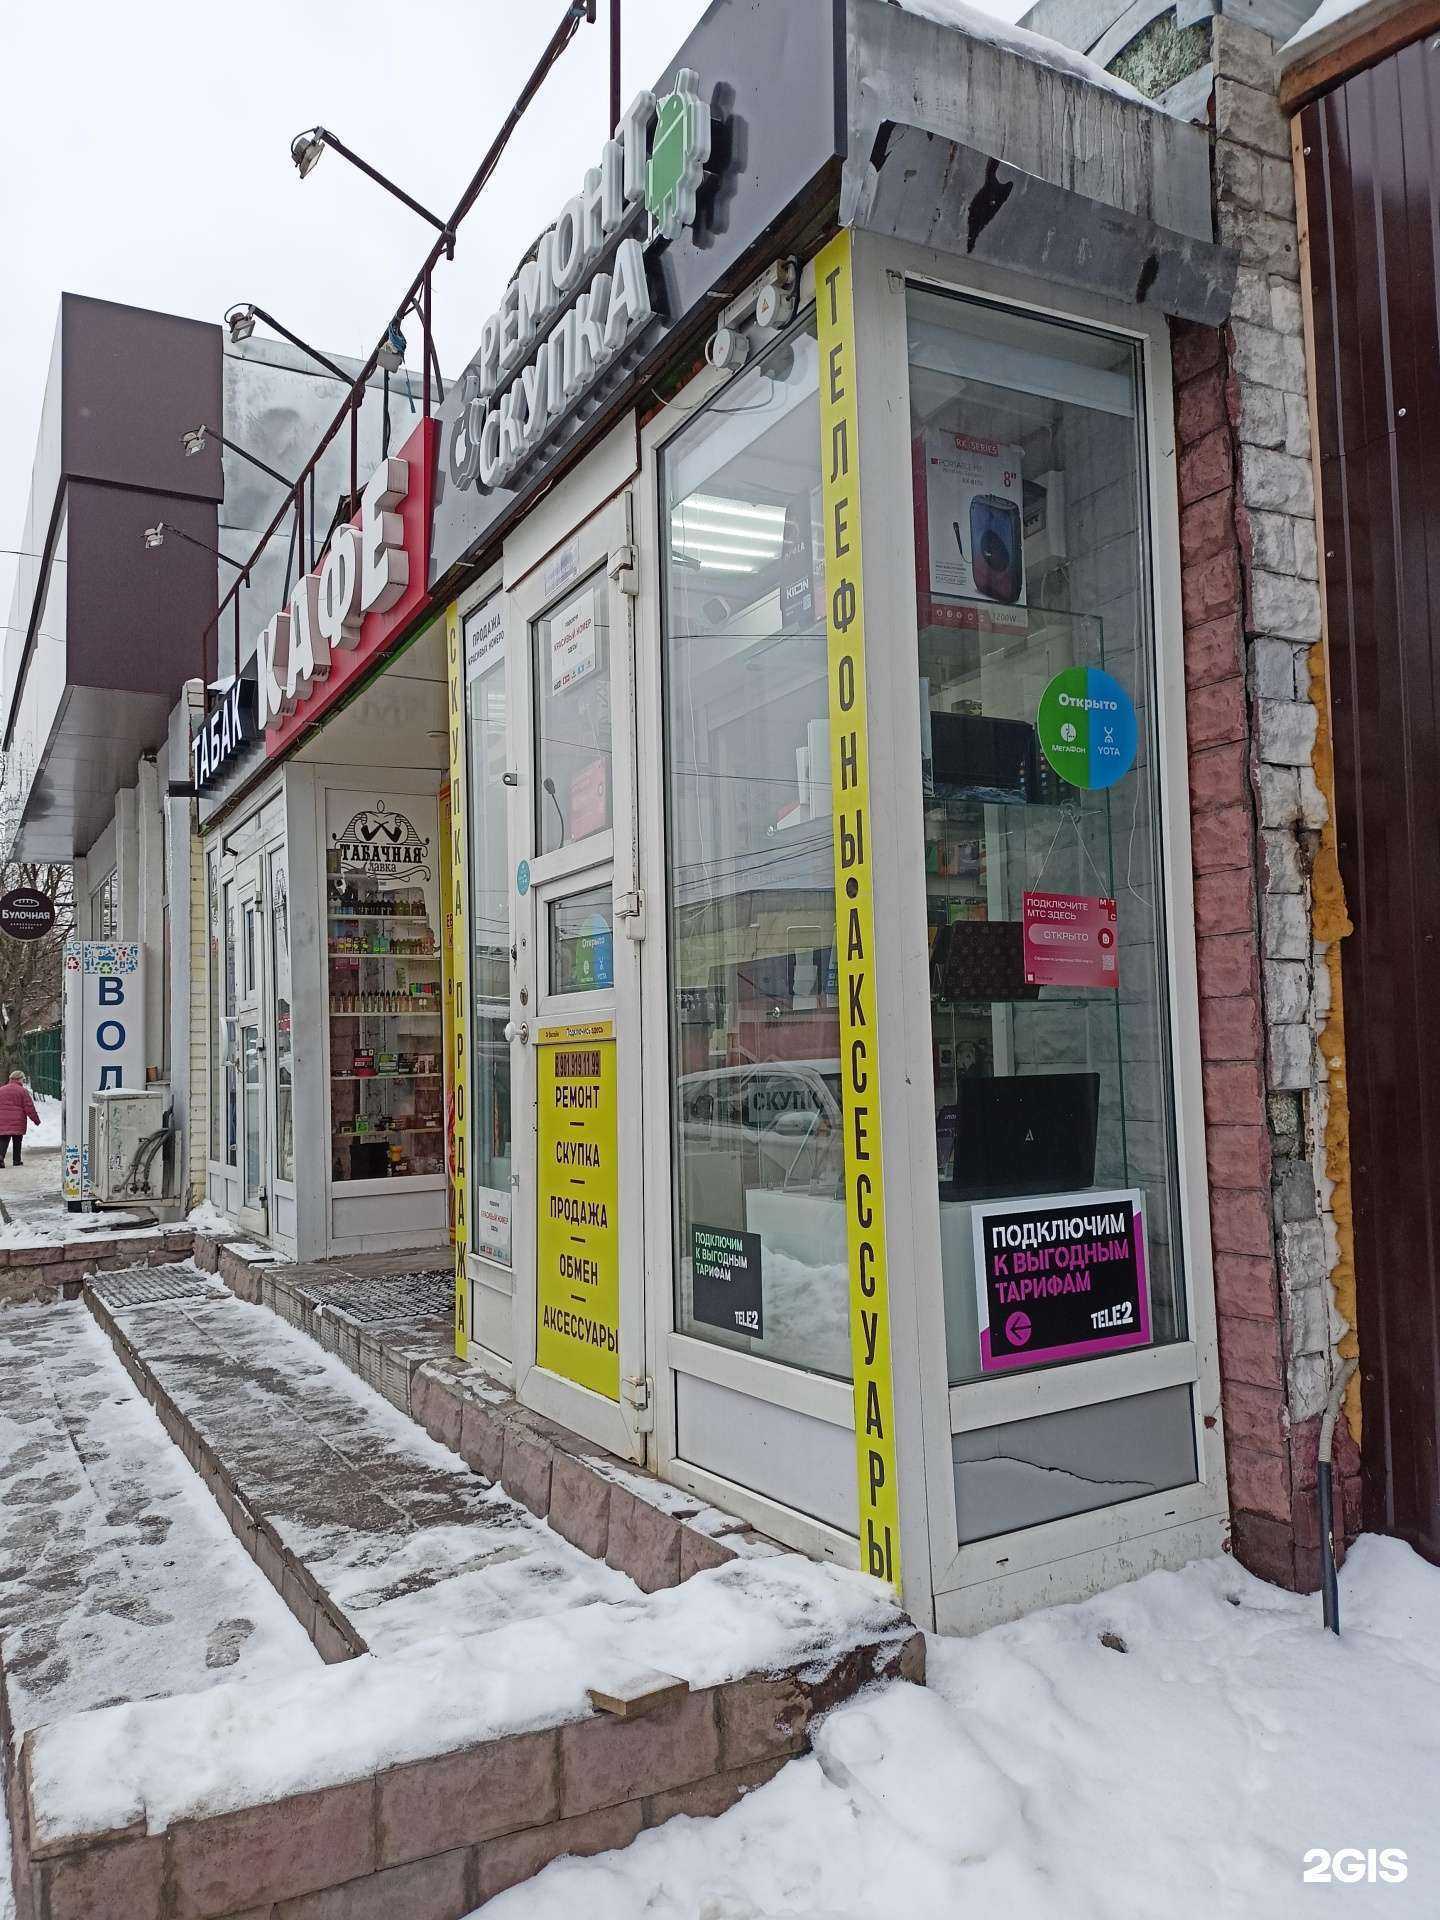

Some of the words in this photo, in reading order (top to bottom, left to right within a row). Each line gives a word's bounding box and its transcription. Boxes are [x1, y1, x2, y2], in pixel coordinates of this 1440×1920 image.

[480, 90, 656, 396] РЕМОНТ
[479, 239, 651, 487] СКУПКА
[825, 266, 863, 867] ТЕЛЕФОНЫ
[257, 457, 410, 730] КАФЕ
[472, 613, 501, 647] ПРОДАЖА
[1059, 693, 1118, 711] Открыто
[192, 679, 242, 790] ТАБАК
[1097, 746, 1121, 756] YOTA
[450, 628, 462, 916] СКУПКА
[340, 843, 423, 864] ТАБАЧНАЯ
[1026, 898, 1089, 911] ПОДКЛЮЧИТЕ
[1027, 909, 1047, 918] МТС
[1047, 910, 1077, 921] ЗДЕСЬ
[1043, 930, 1089, 943] ОТКРЫТО
[555, 1086, 599, 1108] РЕМОНТ
[456, 981, 467, 1334] ПРОДАЖА
[556, 1141, 600, 1167] СКУПКА
[551, 1196, 608, 1228] ПРОДАЖА
[695, 1231, 743, 1251] ПОДКЛЮЧИМ
[846, 908, 893, 1582] АКСЕССУАРЫ
[992, 1213, 1126, 1249] ПОДКЛЮЧИМ
[559, 1253, 598, 1286] ОБМЕН
[695, 1247, 701, 1259] К
[702, 1249, 748, 1269] ВЫГОДНЫМ
[695, 1262, 731, 1282] ТАРИФАМ
[994, 1254, 1009, 1276] К
[1013, 1239, 1129, 1274] ВЫГОДНЫМ
[995, 1271, 1092, 1304] ТАРИФАМ
[543, 1305, 619, 1354] АКСЕССУАРЫ
[735, 1311, 759, 1330] TELE2
[1091, 1301, 1133, 1329] TELE2
